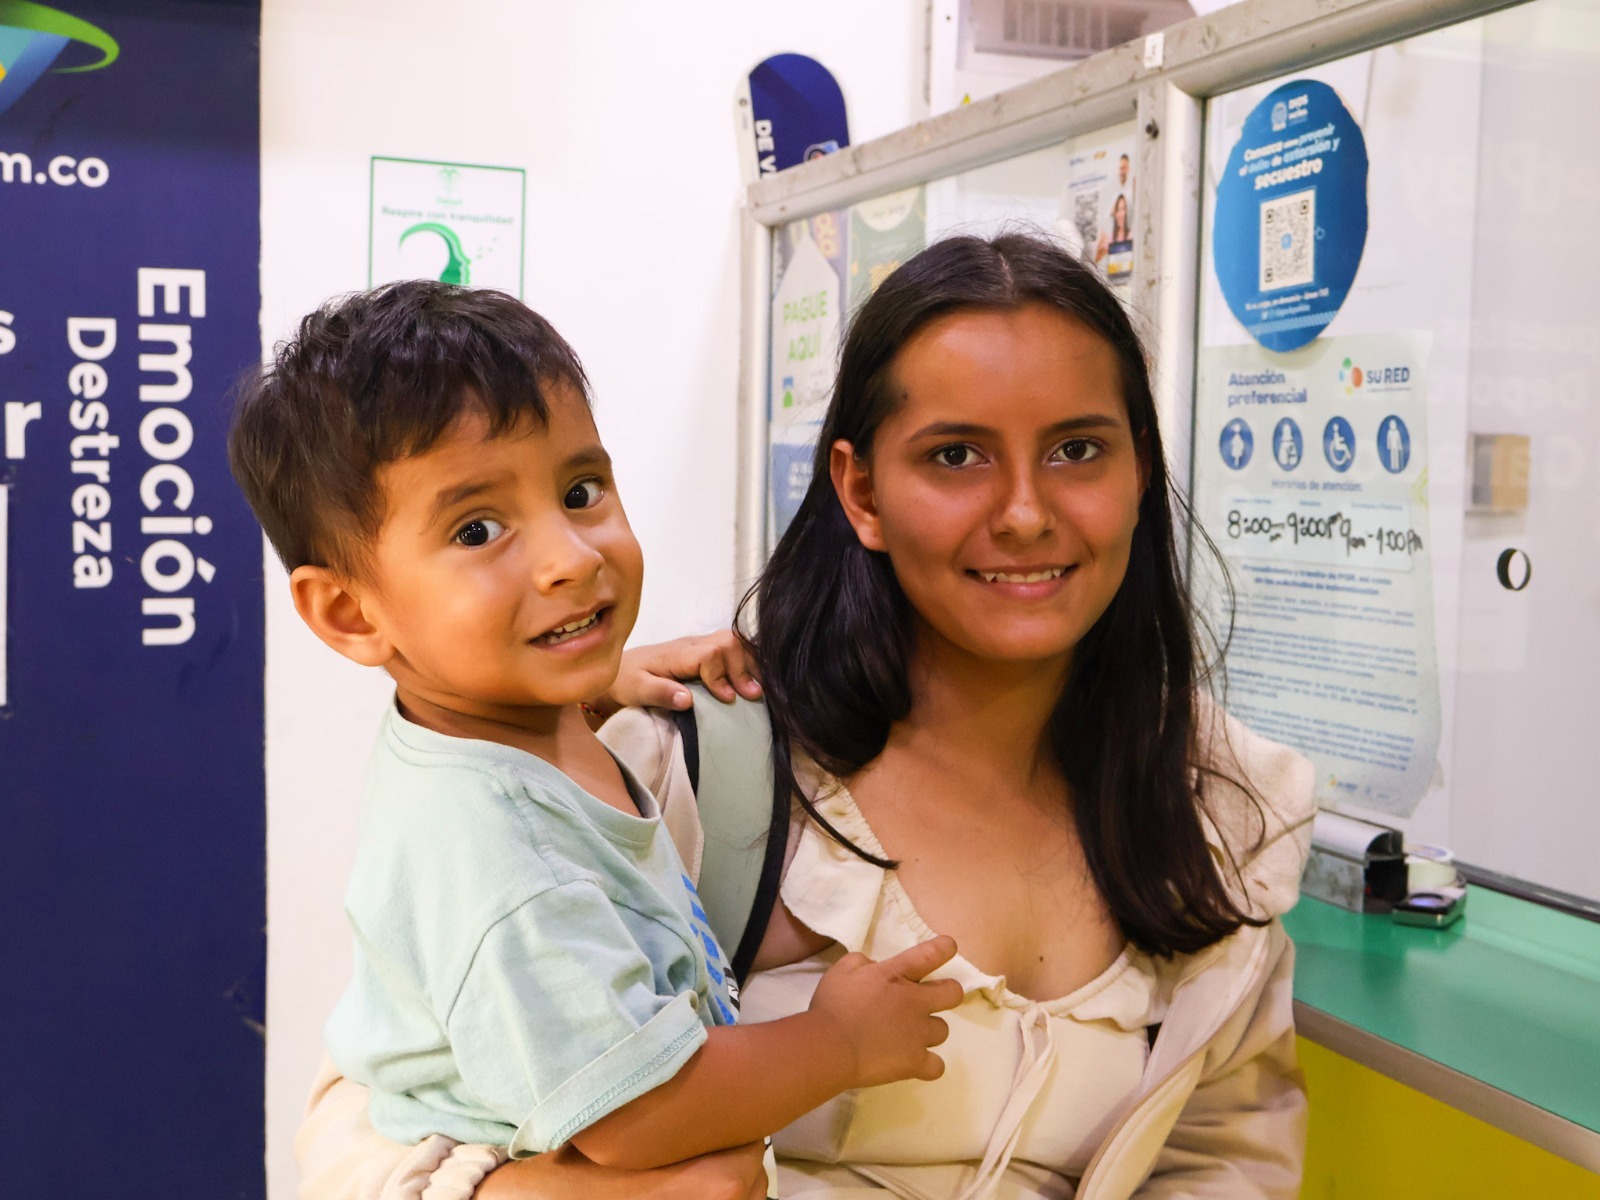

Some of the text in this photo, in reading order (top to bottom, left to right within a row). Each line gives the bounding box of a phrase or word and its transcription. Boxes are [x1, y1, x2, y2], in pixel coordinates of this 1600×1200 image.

[755, 119, 775, 152] DE
[1254, 158, 1324, 190] secuestro
[783, 290, 828, 327] PAGUE
[1228, 369, 1286, 387] Atención
[1228, 387, 1308, 408] preferencial
[67, 317, 120, 589] Destreza
[138, 267, 216, 646] Emoción
